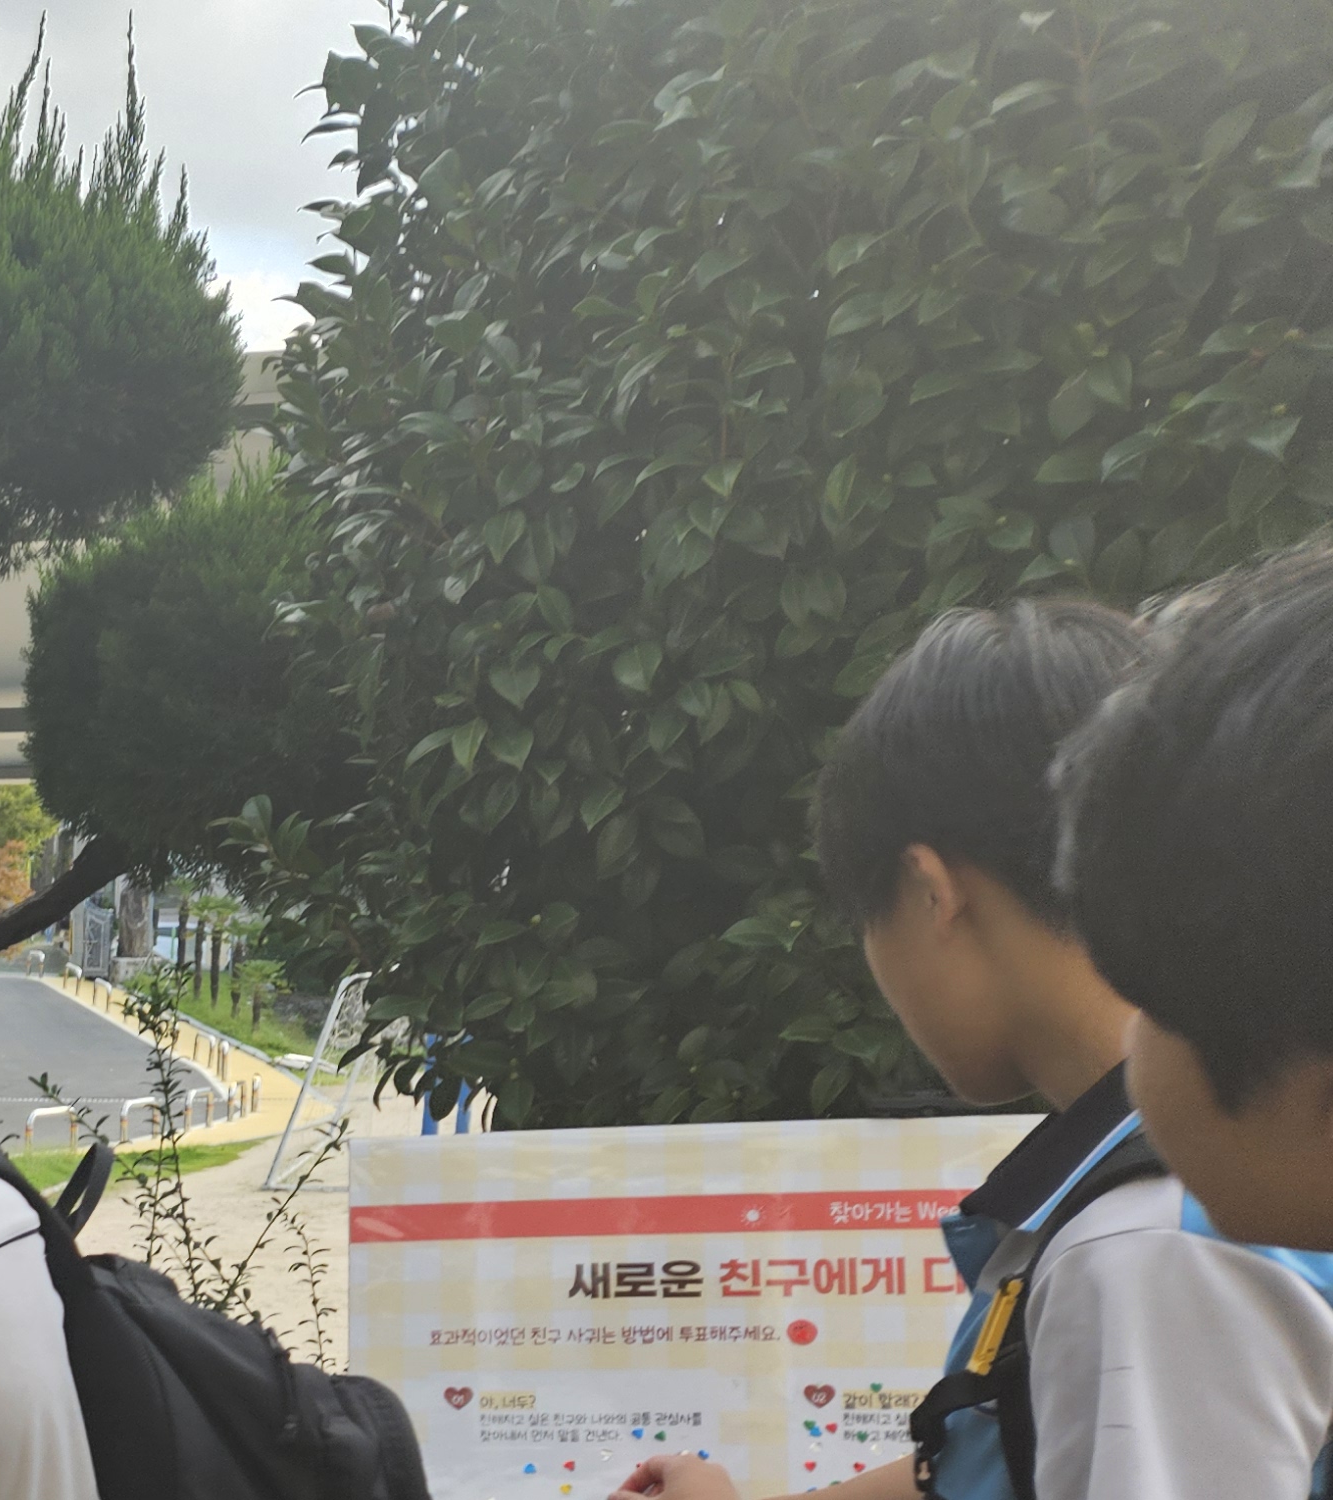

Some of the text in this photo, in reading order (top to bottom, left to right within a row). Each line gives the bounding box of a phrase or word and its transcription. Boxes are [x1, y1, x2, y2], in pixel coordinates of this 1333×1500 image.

[829, 1201, 913, 1225] 찾아가는
[569, 1260, 703, 1299] 새로운
[720, 1257, 906, 1297] 친구에게
[430, 1324, 780, 1347] 효과적이었던 친구 사귀는 방법에 투표해주세요.
[502, 1394, 536, 1409] 너두?
[843, 1391, 919, 1409] 같이 할래?
[480, 1412, 702, 1426] 친해지고 싶은 친구와 나와의 공통 관심사를
[843, 1412, 891, 1426] 친해지고
[480, 1430, 528, 1443] 찾아내서
[532, 1429, 554, 1442] 먼저
[558, 1429, 580, 1442] 말을
[844, 1430, 881, 1441] 하고
